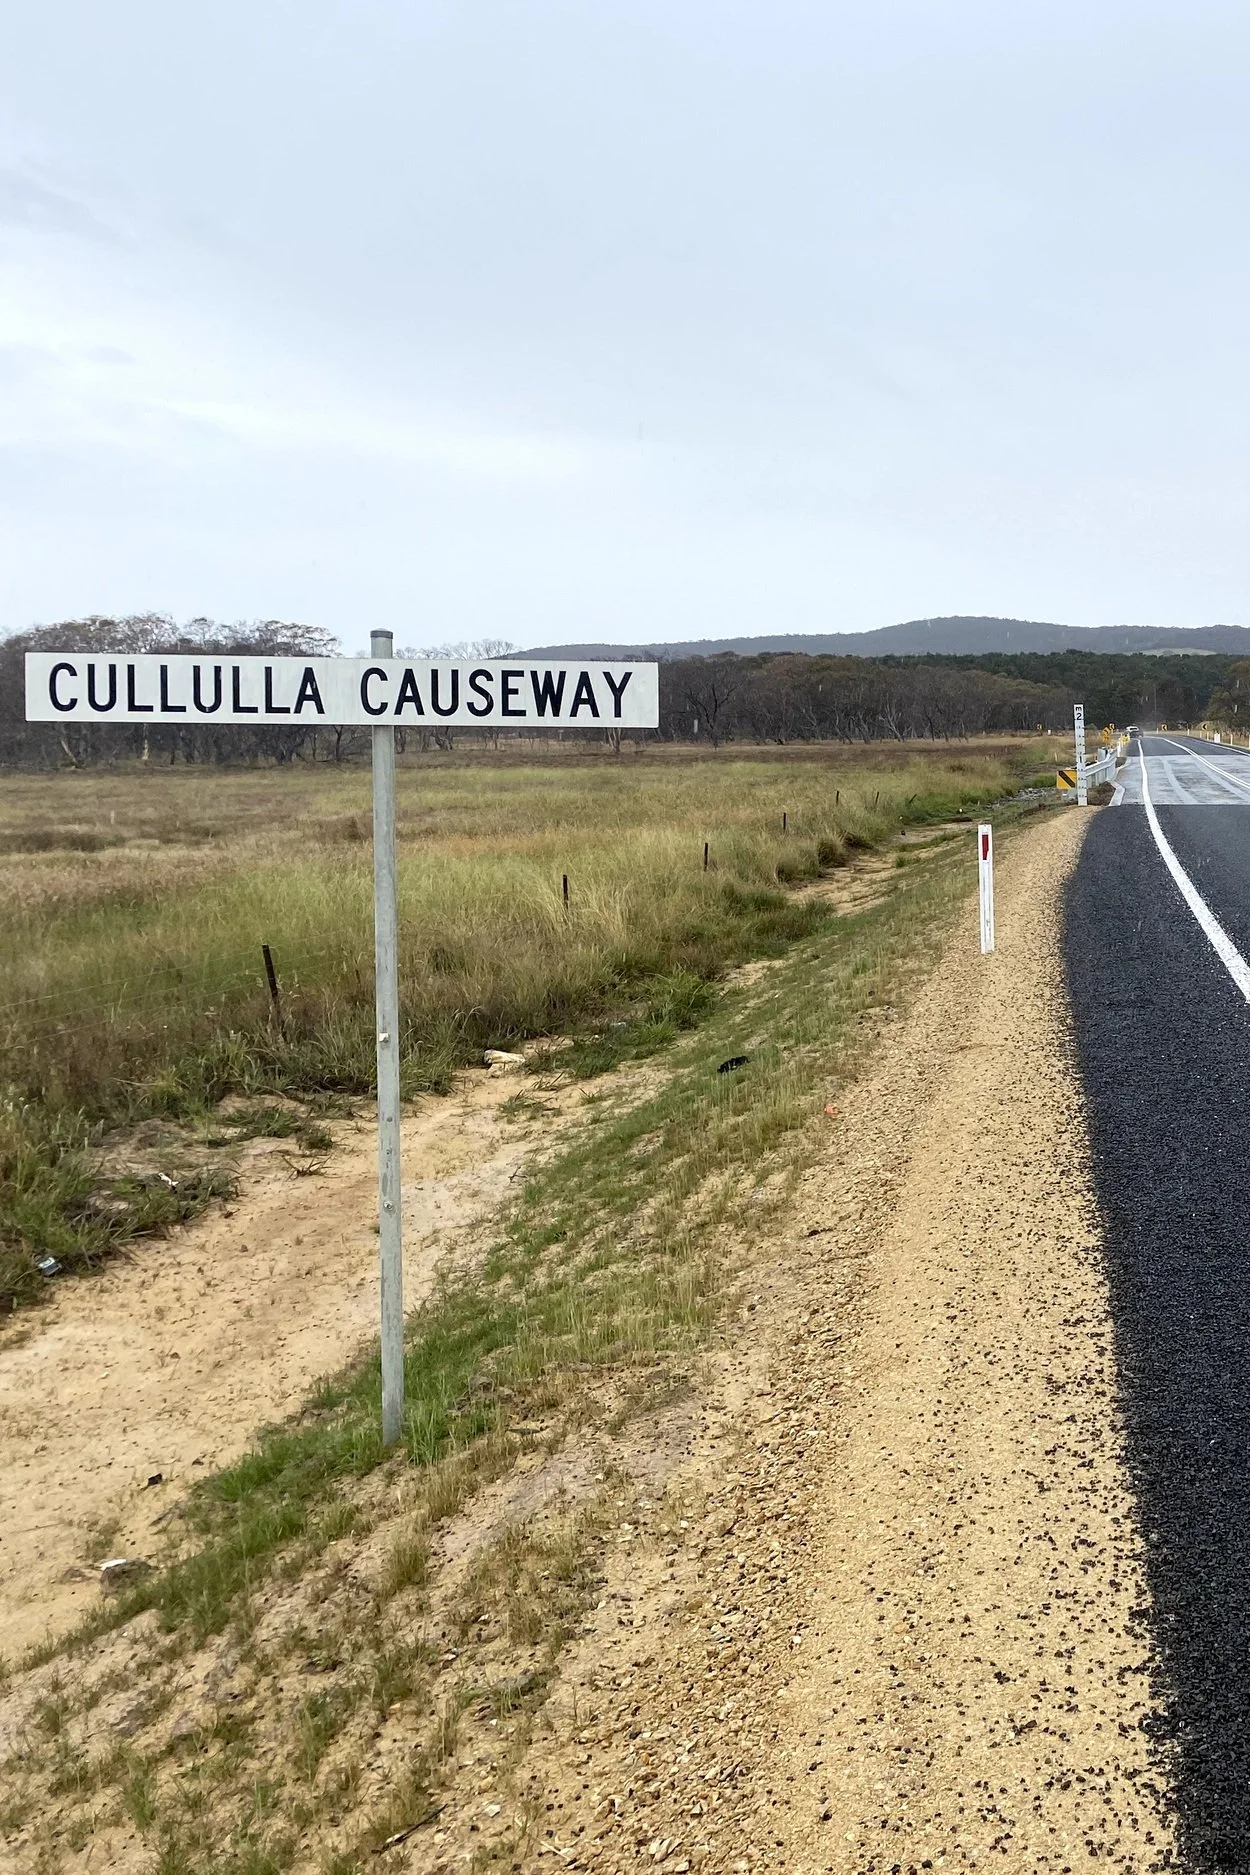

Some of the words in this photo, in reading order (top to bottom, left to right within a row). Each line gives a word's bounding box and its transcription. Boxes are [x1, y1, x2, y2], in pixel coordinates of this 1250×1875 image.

[49, 662, 325, 714] CULLULLA
[360, 667, 633, 718] CAUSEWAY
[1076, 712, 1082, 720] 2
